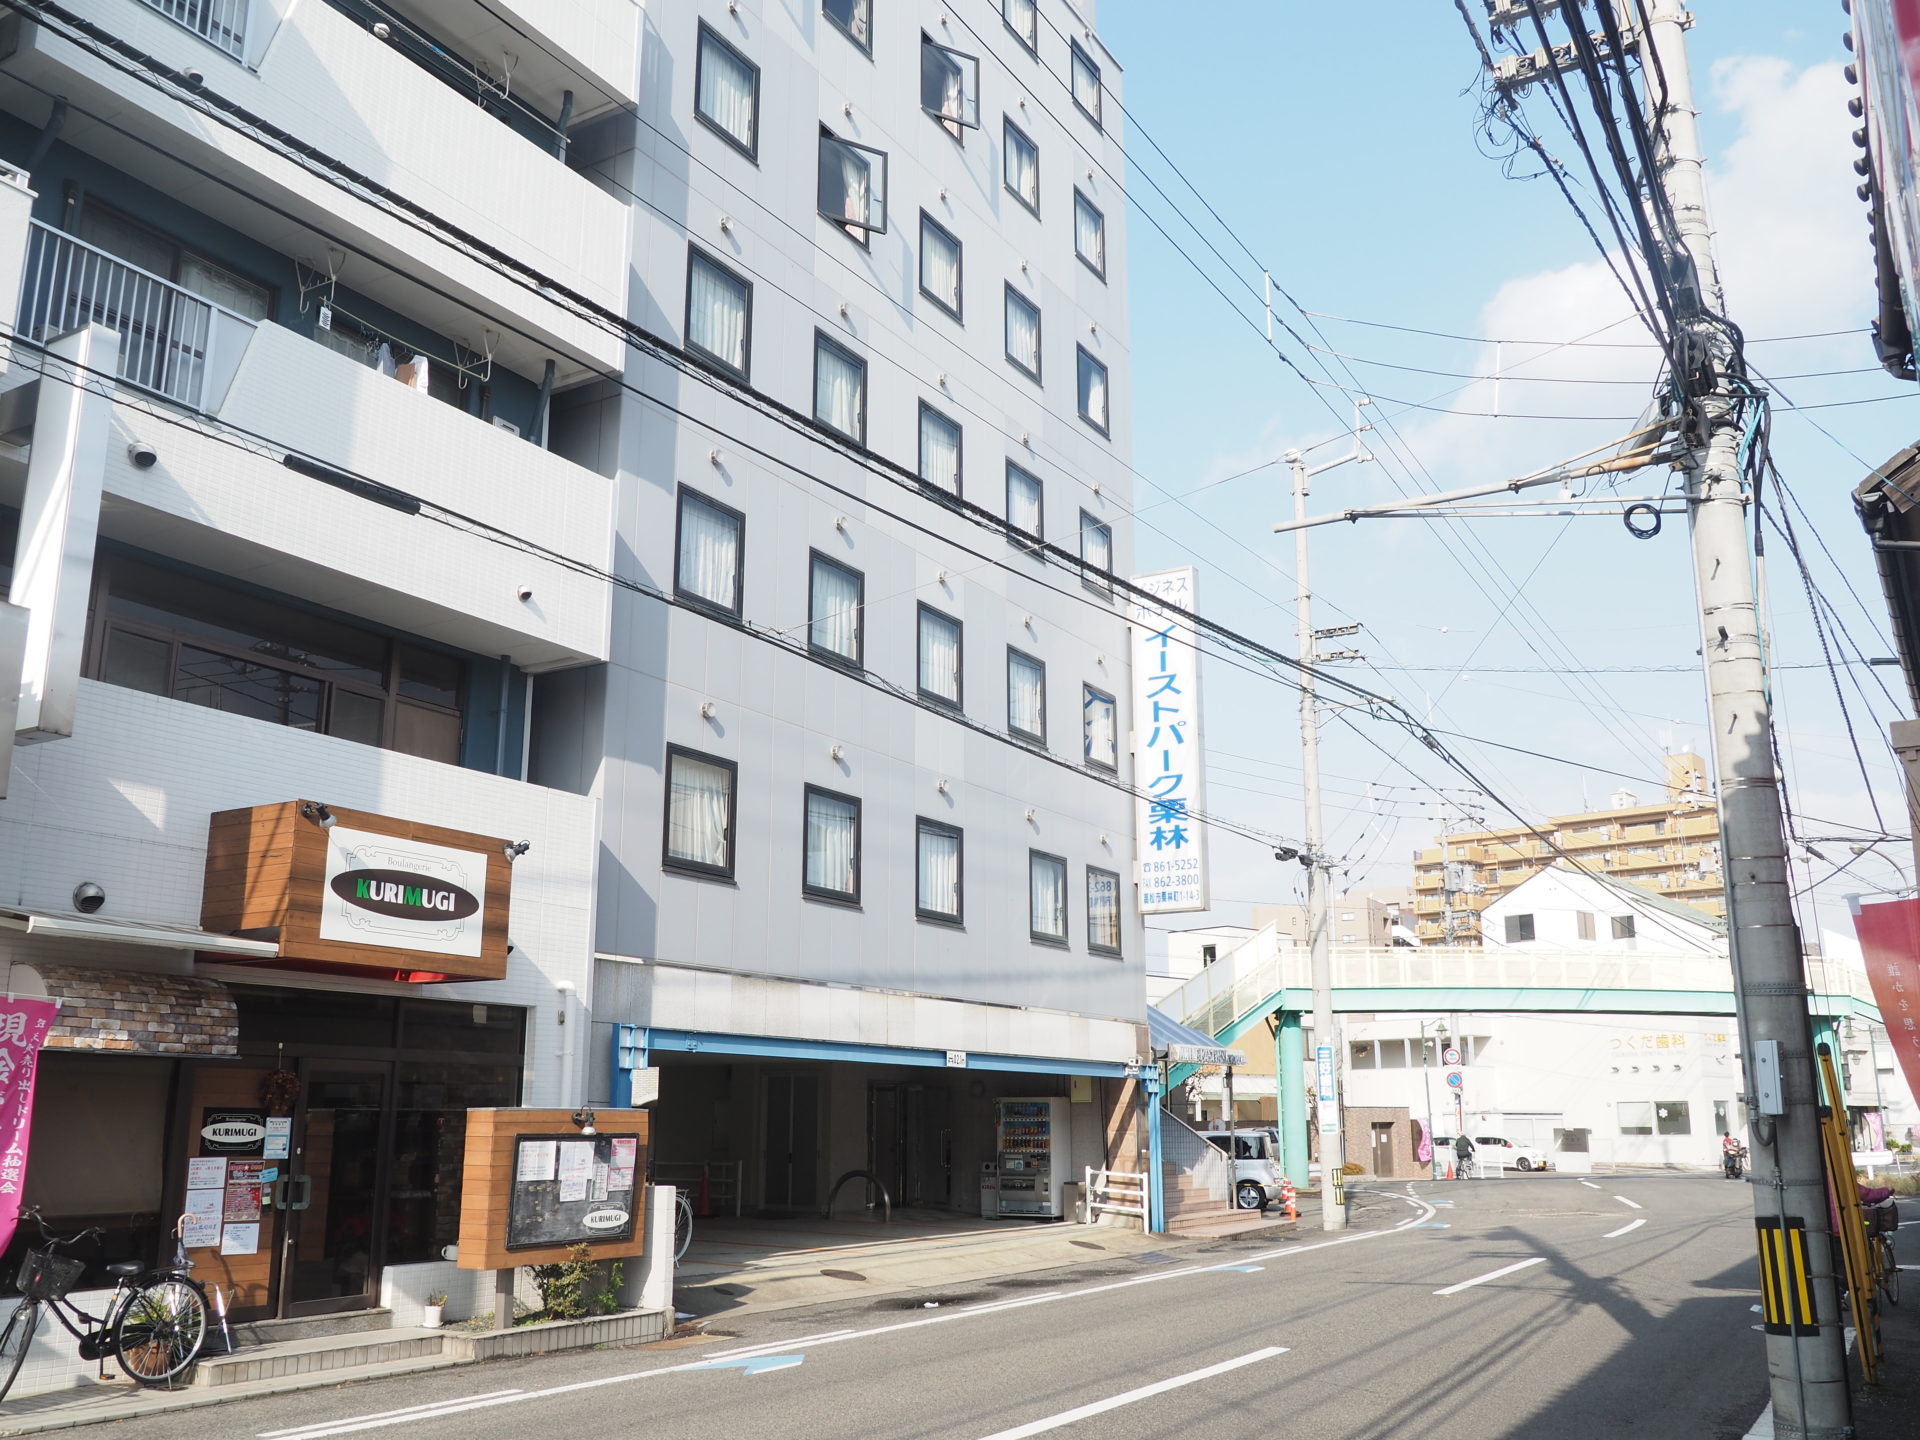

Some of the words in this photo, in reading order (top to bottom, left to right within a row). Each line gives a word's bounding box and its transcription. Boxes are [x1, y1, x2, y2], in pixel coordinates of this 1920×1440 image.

[1135, 577, 1188, 599] ジネス
[1145, 625, 1190, 850] イーストパーク栗林
[387, 856, 432, 873] Boulangerie
[1153, 858, 1199, 873] 861-5252
[1154, 874, 1199, 888] 862-3800
[356, 878, 456, 912] KURIMUGI
[1609, 1032, 1687, 1050] つくだ歯科
[212, 1127, 257, 1137] KURIMUGI
[590, 1214, 622, 1223] KURIMUGI
